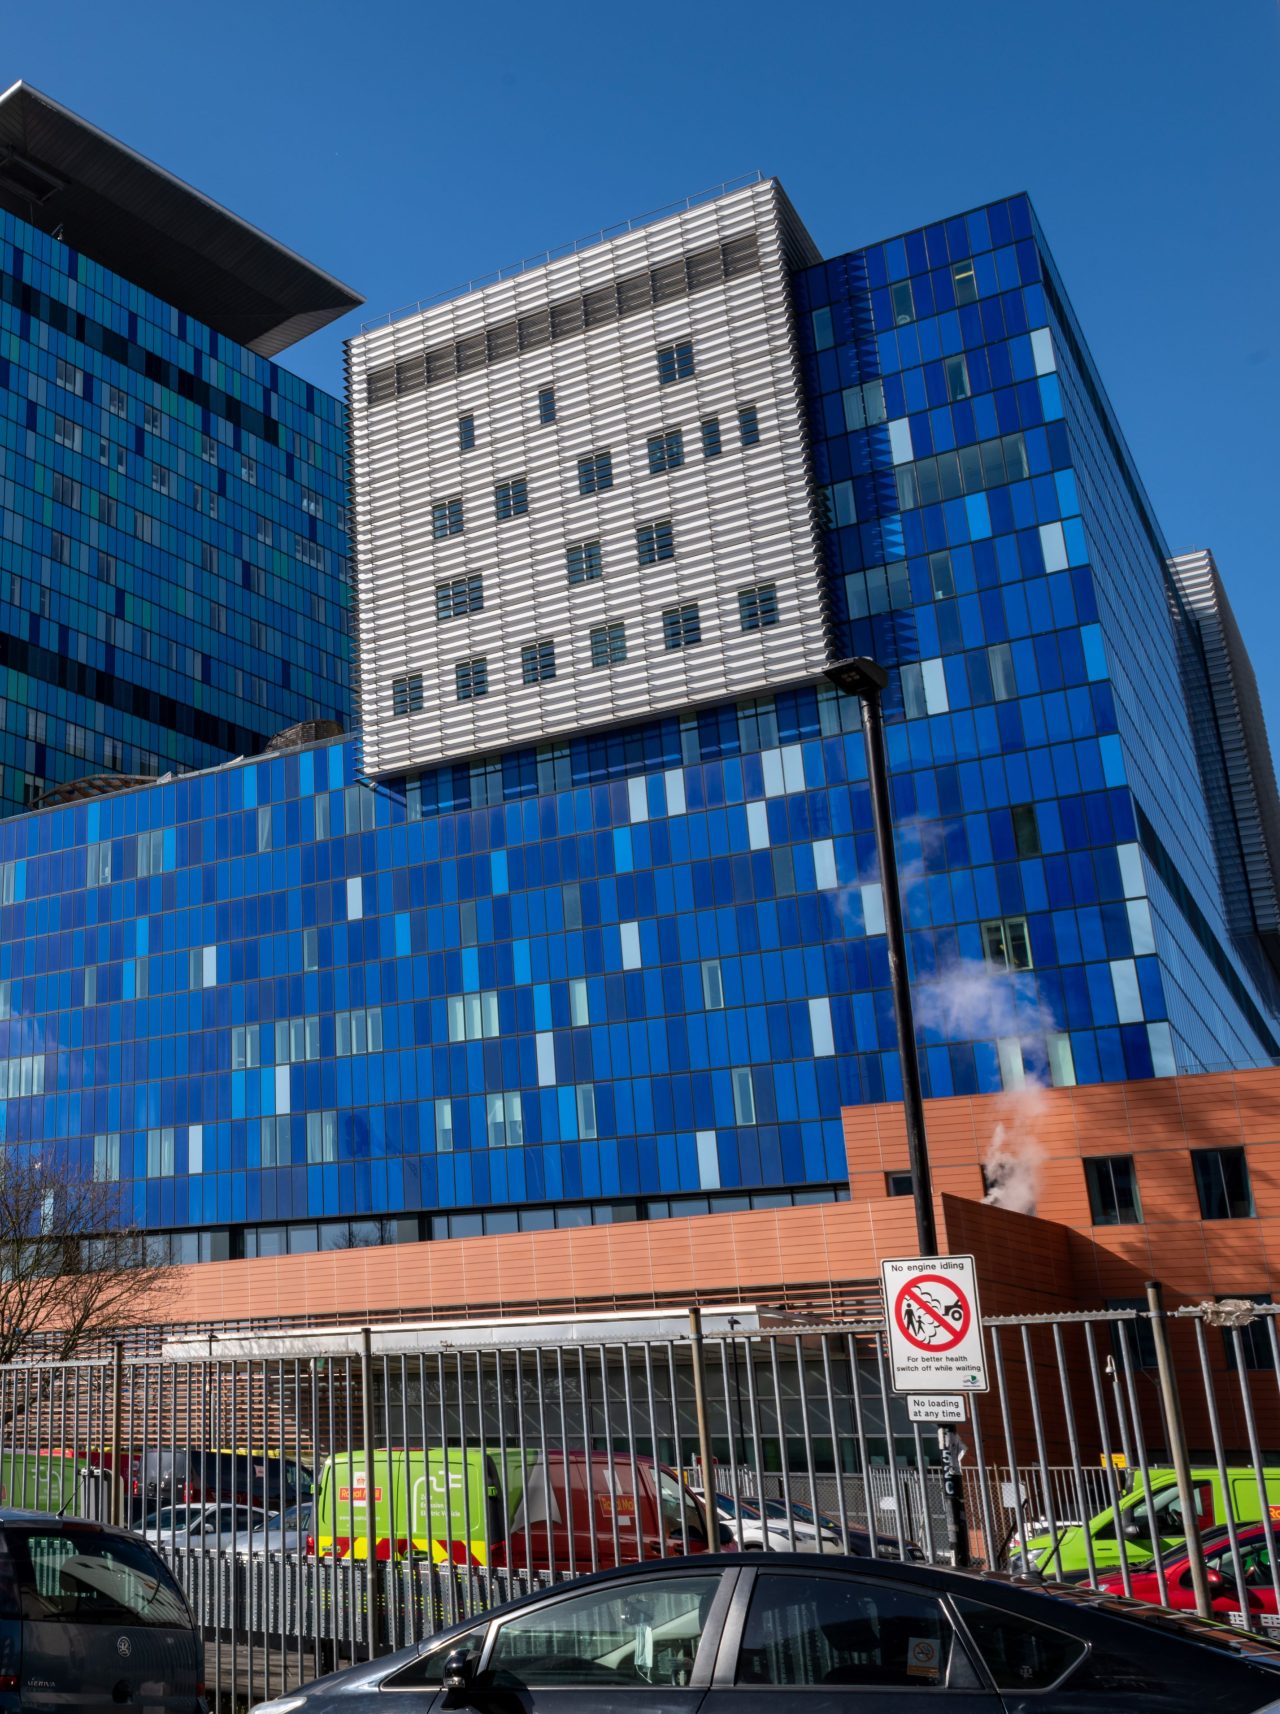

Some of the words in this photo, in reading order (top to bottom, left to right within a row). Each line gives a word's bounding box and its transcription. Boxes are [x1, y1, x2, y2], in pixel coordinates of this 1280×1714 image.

[891, 1264, 904, 1272] No
[907, 1262, 937, 1273] engine
[940, 1261, 964, 1271] idling
[921, 1355, 943, 1363] better
[945, 1355, 968, 1363] health
[955, 1364, 982, 1373] waiting
[913, 1399, 926, 1408] No
[928, 1399, 960, 1409] loading
[913, 1409, 922, 1418] at
[924, 1411, 940, 1419] any
[942, 1410, 961, 1418] time
